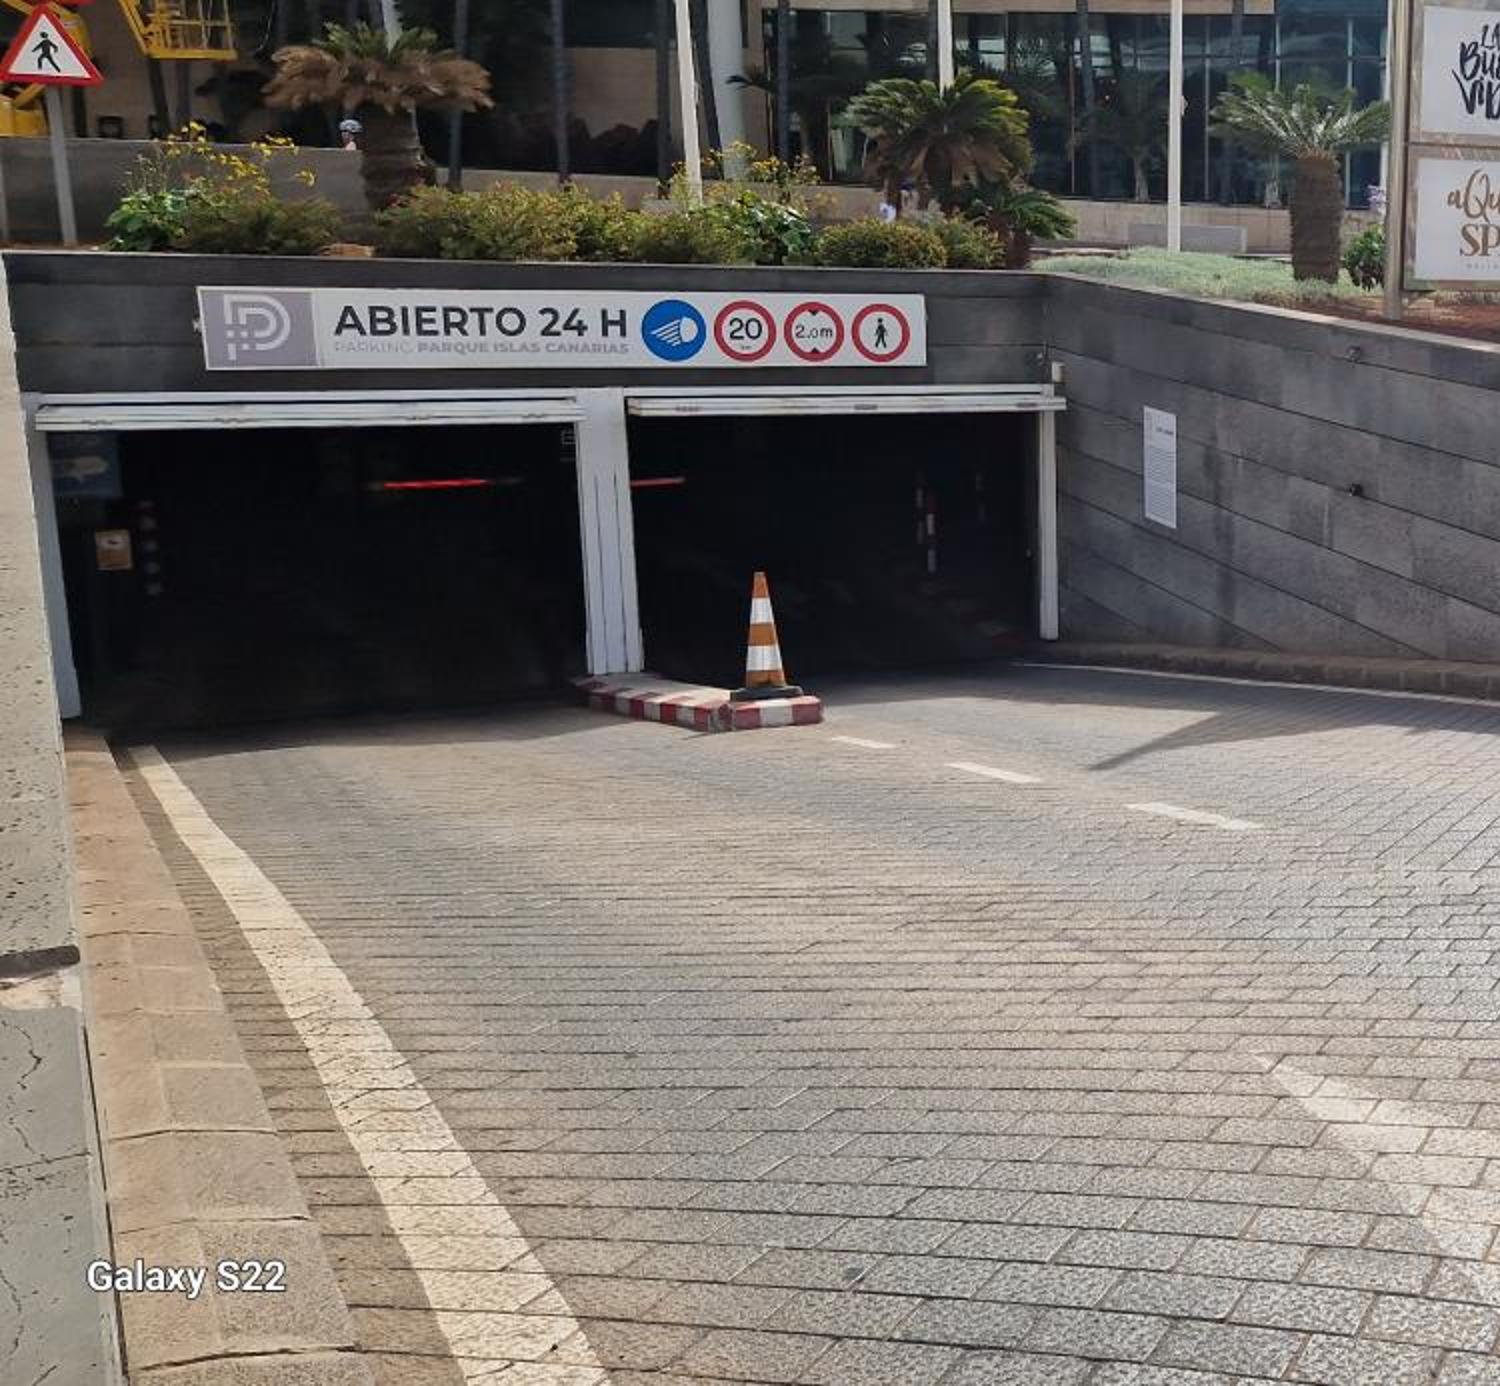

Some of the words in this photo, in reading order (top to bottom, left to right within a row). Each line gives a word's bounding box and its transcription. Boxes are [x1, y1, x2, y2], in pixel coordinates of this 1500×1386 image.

[1480, 22, 1500, 51] LA
[335, 305, 527, 337] ABIERTO
[538, 307, 589, 337] 24
[601, 308, 627, 338] H
[729, 317, 763, 341] 20
[417, 342, 489, 355] PARQUE
[494, 342, 541, 353] ISLAS
[545, 343, 630, 354] CANARIAS
